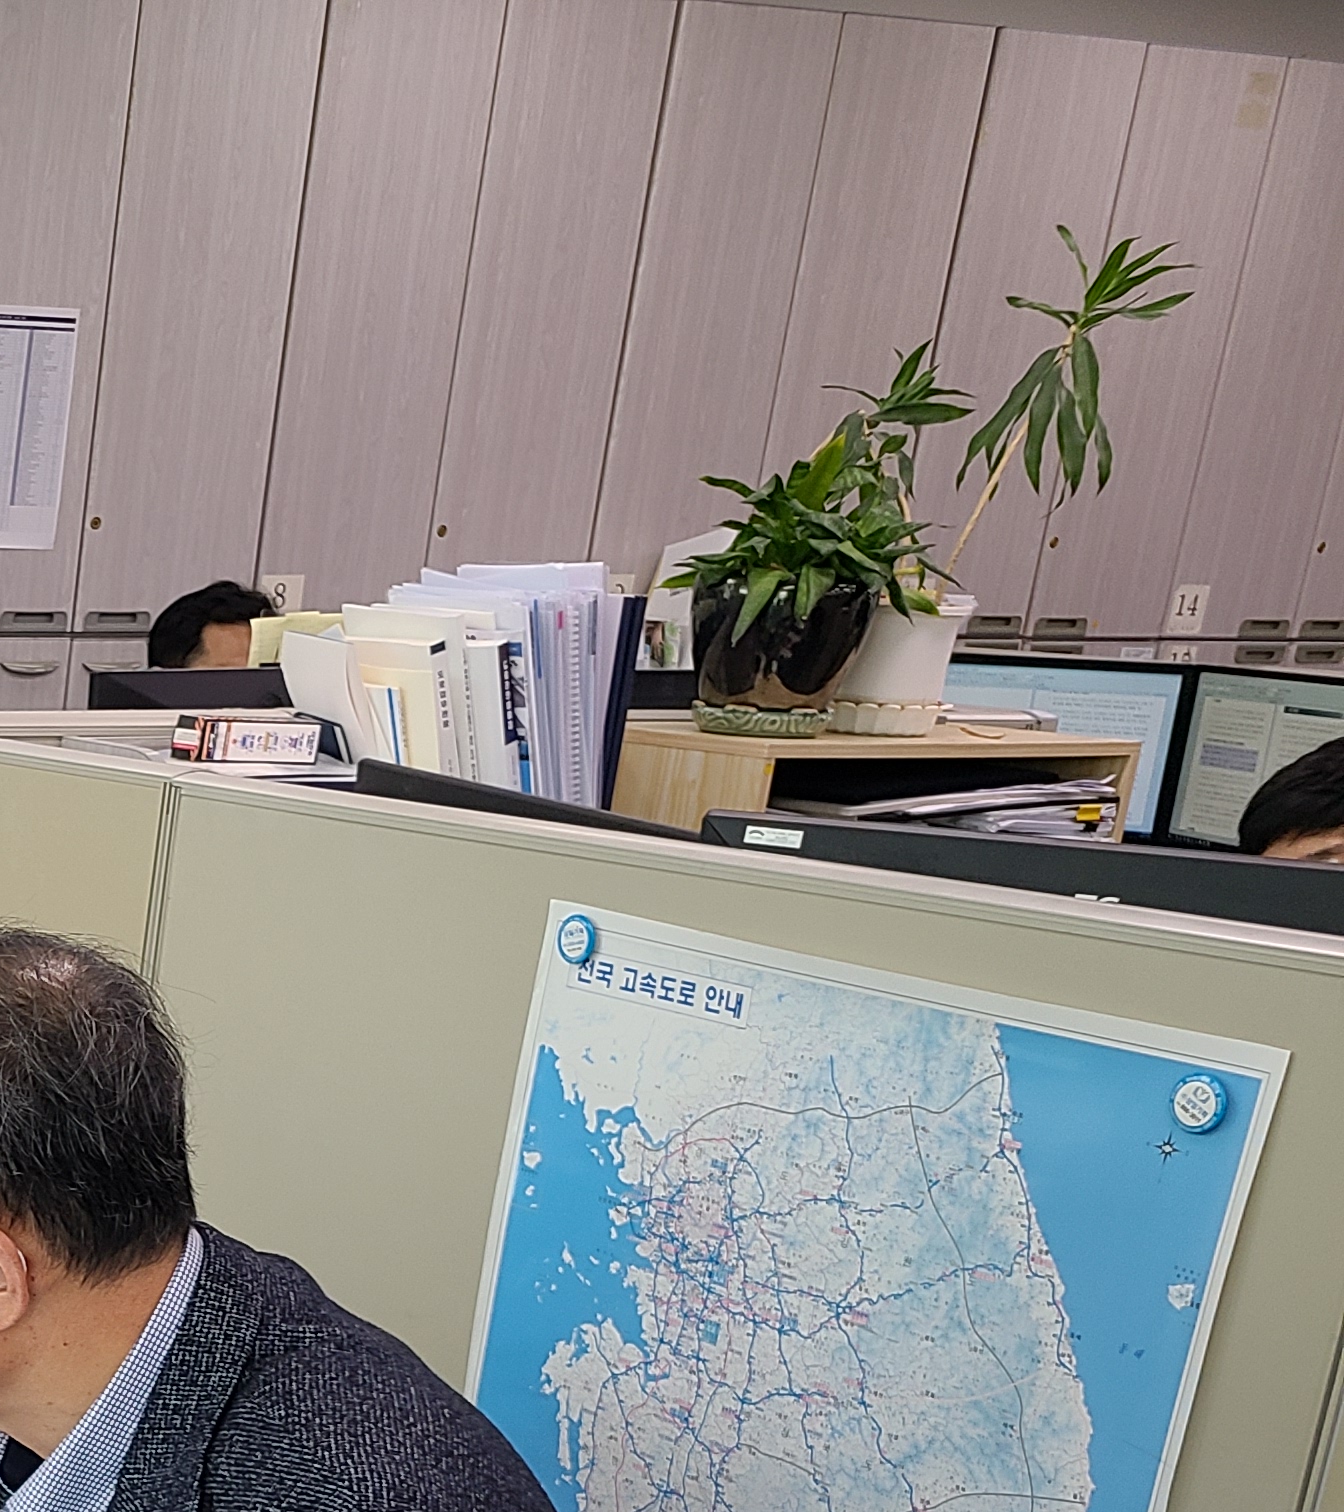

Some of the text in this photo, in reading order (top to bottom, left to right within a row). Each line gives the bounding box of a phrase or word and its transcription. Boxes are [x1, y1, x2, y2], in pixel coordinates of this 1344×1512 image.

[273, 583, 287, 609] 8
[1175, 592, 1199, 617] 14
[577, 958, 745, 1020] 전국 고속도로 안내
